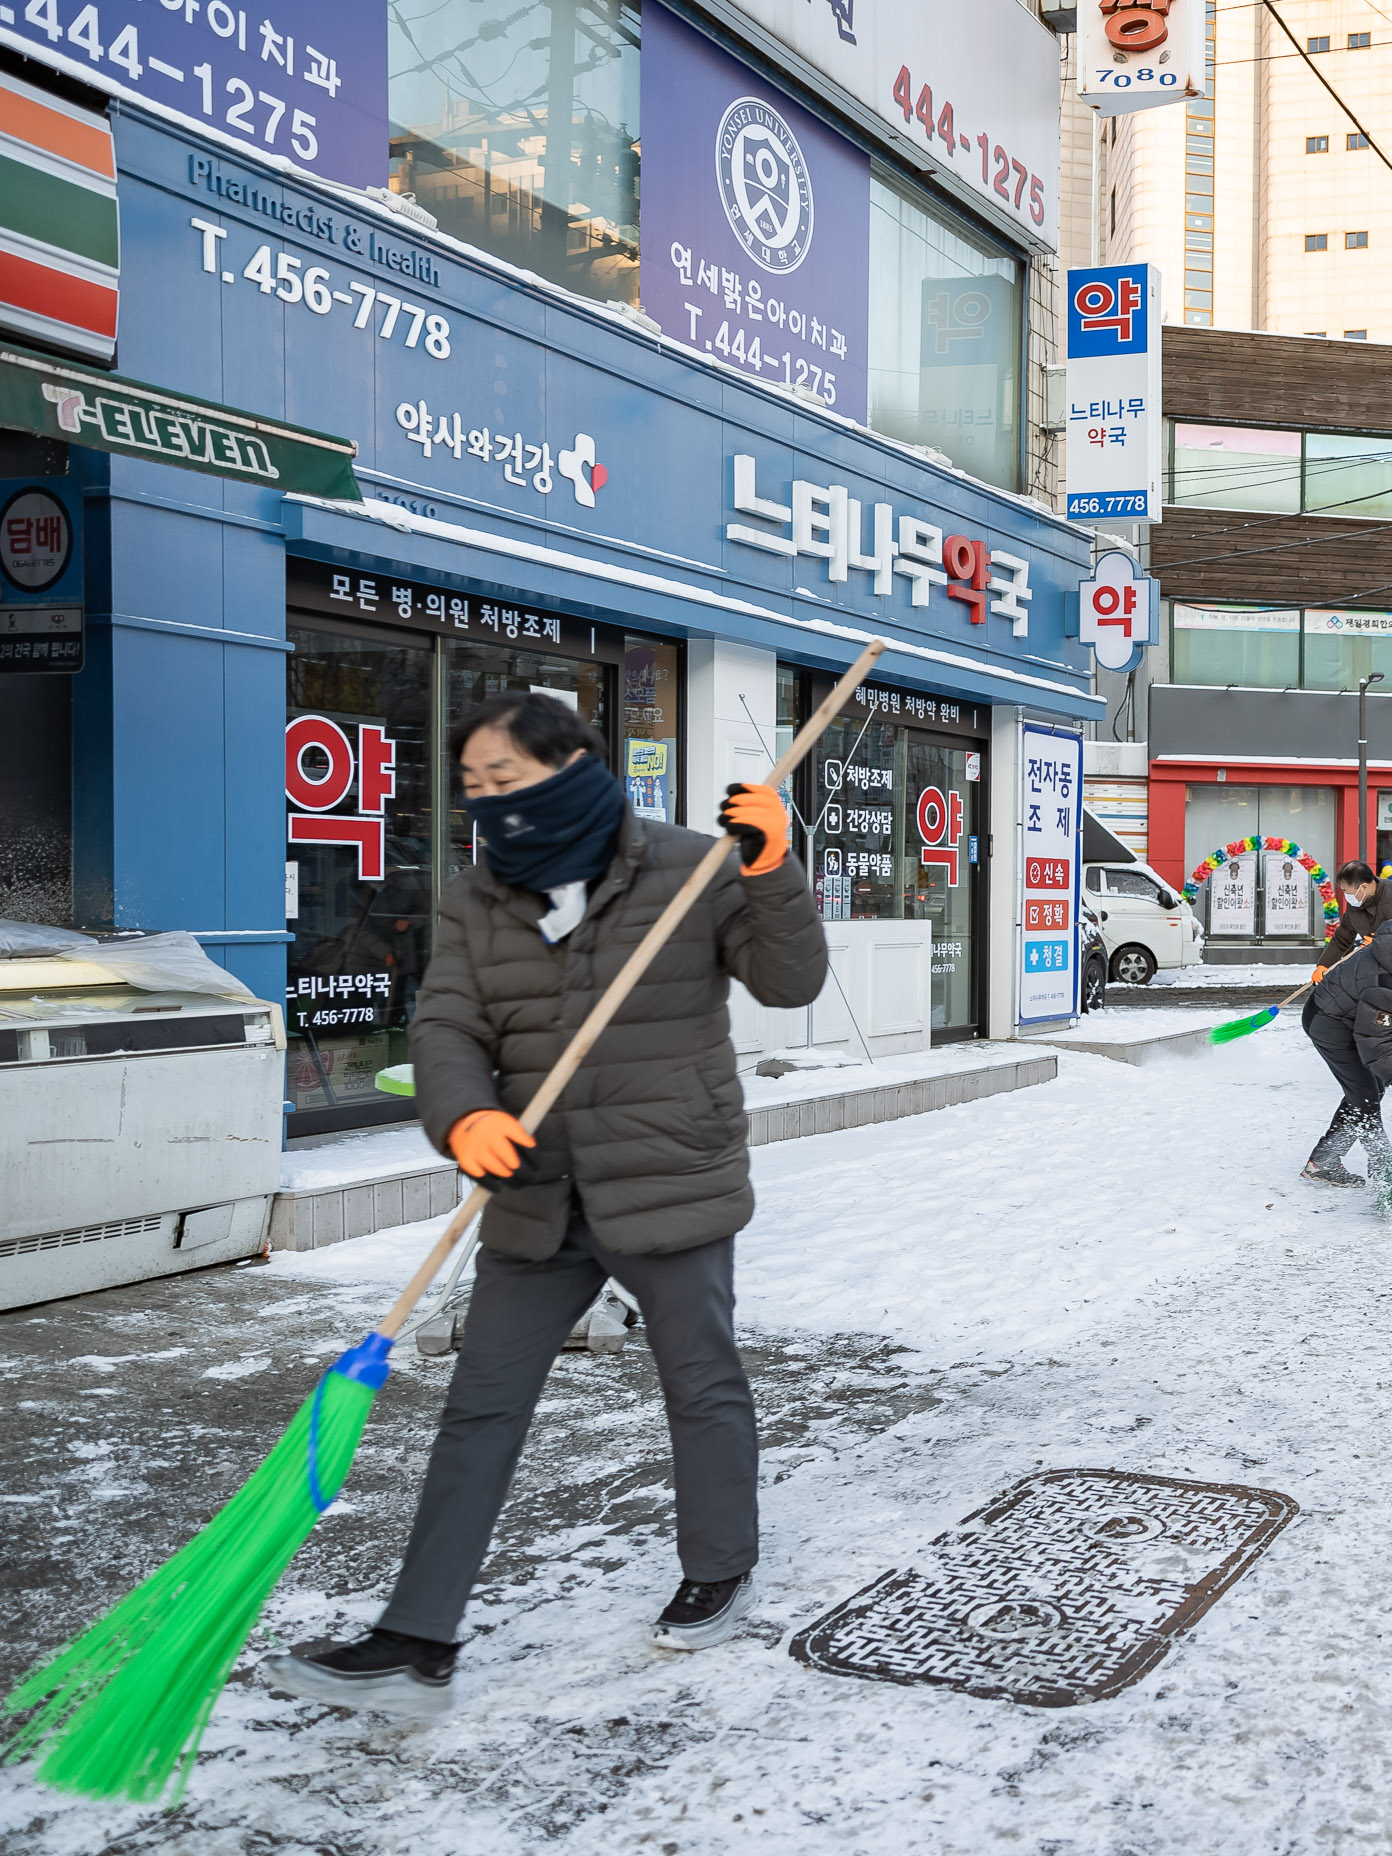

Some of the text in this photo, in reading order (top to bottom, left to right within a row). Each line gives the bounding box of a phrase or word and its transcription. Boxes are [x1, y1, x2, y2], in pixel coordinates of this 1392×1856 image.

[1095, 68, 1177, 88] 7080
[722, 108, 810, 211] YONSEI UNIVERSITY
[892, 64, 1045, 226] 444-1275
[188, 154, 443, 288] Pharmacist & health
[730, 204, 802, 265] 연세대학교
[759, 219, 773, 233] 1885
[670, 241, 848, 361] 연세밝은아이치과
[1074, 277, 1142, 343] 약
[684, 302, 836, 406] T.444-1275
[1069, 398, 1146, 421] 느티나무
[1087, 427, 1127, 448] 약국
[1069, 494, 1146, 515] 456.7778
[7, 516, 62, 554] 담배
[726, 454, 1032, 638] 느티나무약국
[330, 574, 561, 644] 모든 병·의원 처방조제
[1092, 585, 1137, 638] 약
[855, 686, 960, 723] 혜민병원 처방약 완비
[846, 765, 893, 791] 처방조제
[1028, 758, 1073, 799] 전자동
[285, 714, 396, 881] 약
[846, 809, 893, 835] 건강상담
[917, 785, 964, 888] 약
[846, 852, 893, 877] 동물약품
[1043, 863, 1064, 884] 신속
[1223, 883, 1244, 897] 신축년
[1277, 883, 1298, 897] 신축년
[1043, 904, 1064, 926] 정확
[930, 942, 962, 958] 나무약국
[1043, 945, 1064, 967] 청결
[312, 1007, 374, 1026] 456-7778
